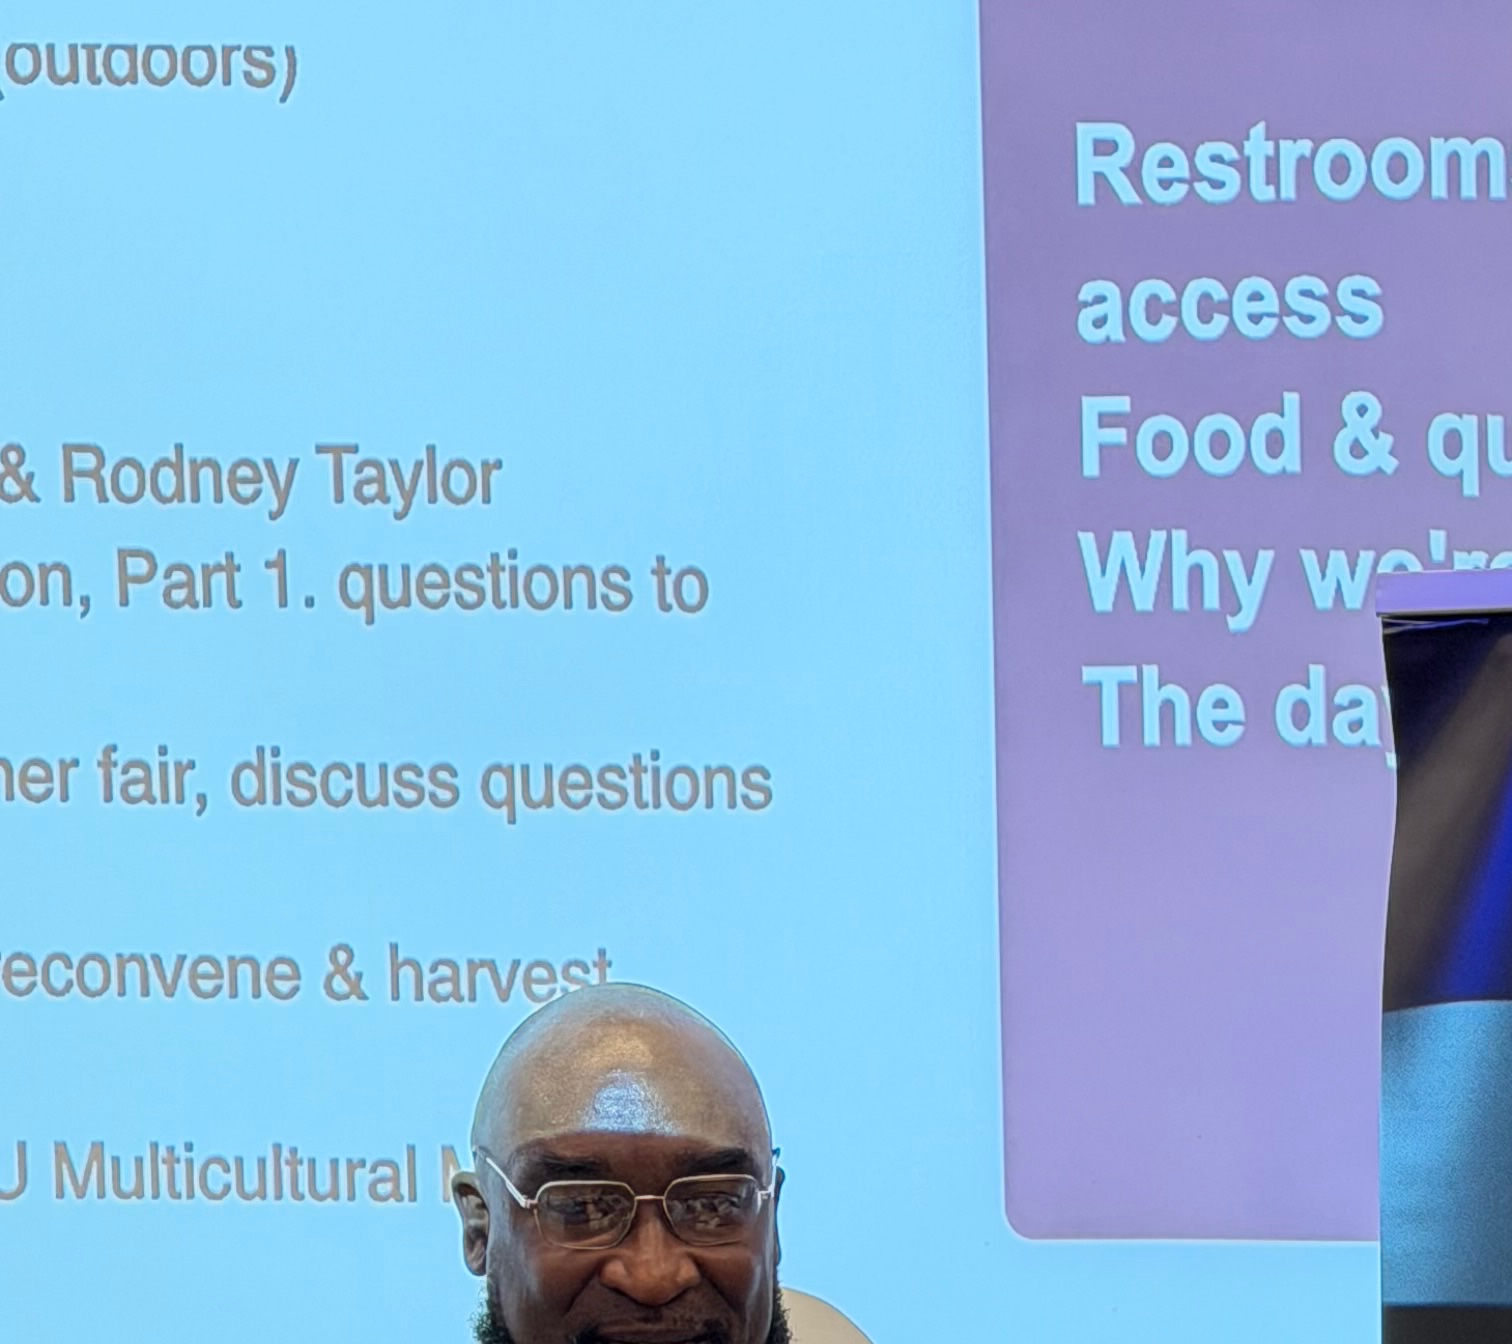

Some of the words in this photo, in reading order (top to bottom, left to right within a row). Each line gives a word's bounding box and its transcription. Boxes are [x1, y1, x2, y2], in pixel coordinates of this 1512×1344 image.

[0, 43, 297, 103] outdoors)
[1076, 273, 1385, 344] access
[1079, 391, 1303, 479] Food
[1333, 390, 1400, 478] &
[61, 442, 300, 522] Rodney
[314, 443, 503, 522] Taylor
[116, 546, 243, 611] Part
[263, 548, 316, 611] 1.
[337, 549, 634, 626] questions
[651, 554, 710, 613] to
[1077, 528, 1275, 634] Why
[1082, 663, 1245, 747] The
[97, 743, 208, 817] fair,
[230, 745, 461, 811] discuss
[479, 750, 774, 826] questions
[323, 942, 370, 1002] &
[389, 942, 613, 1004] harvest
[54, 1140, 417, 1204] Multicultural
